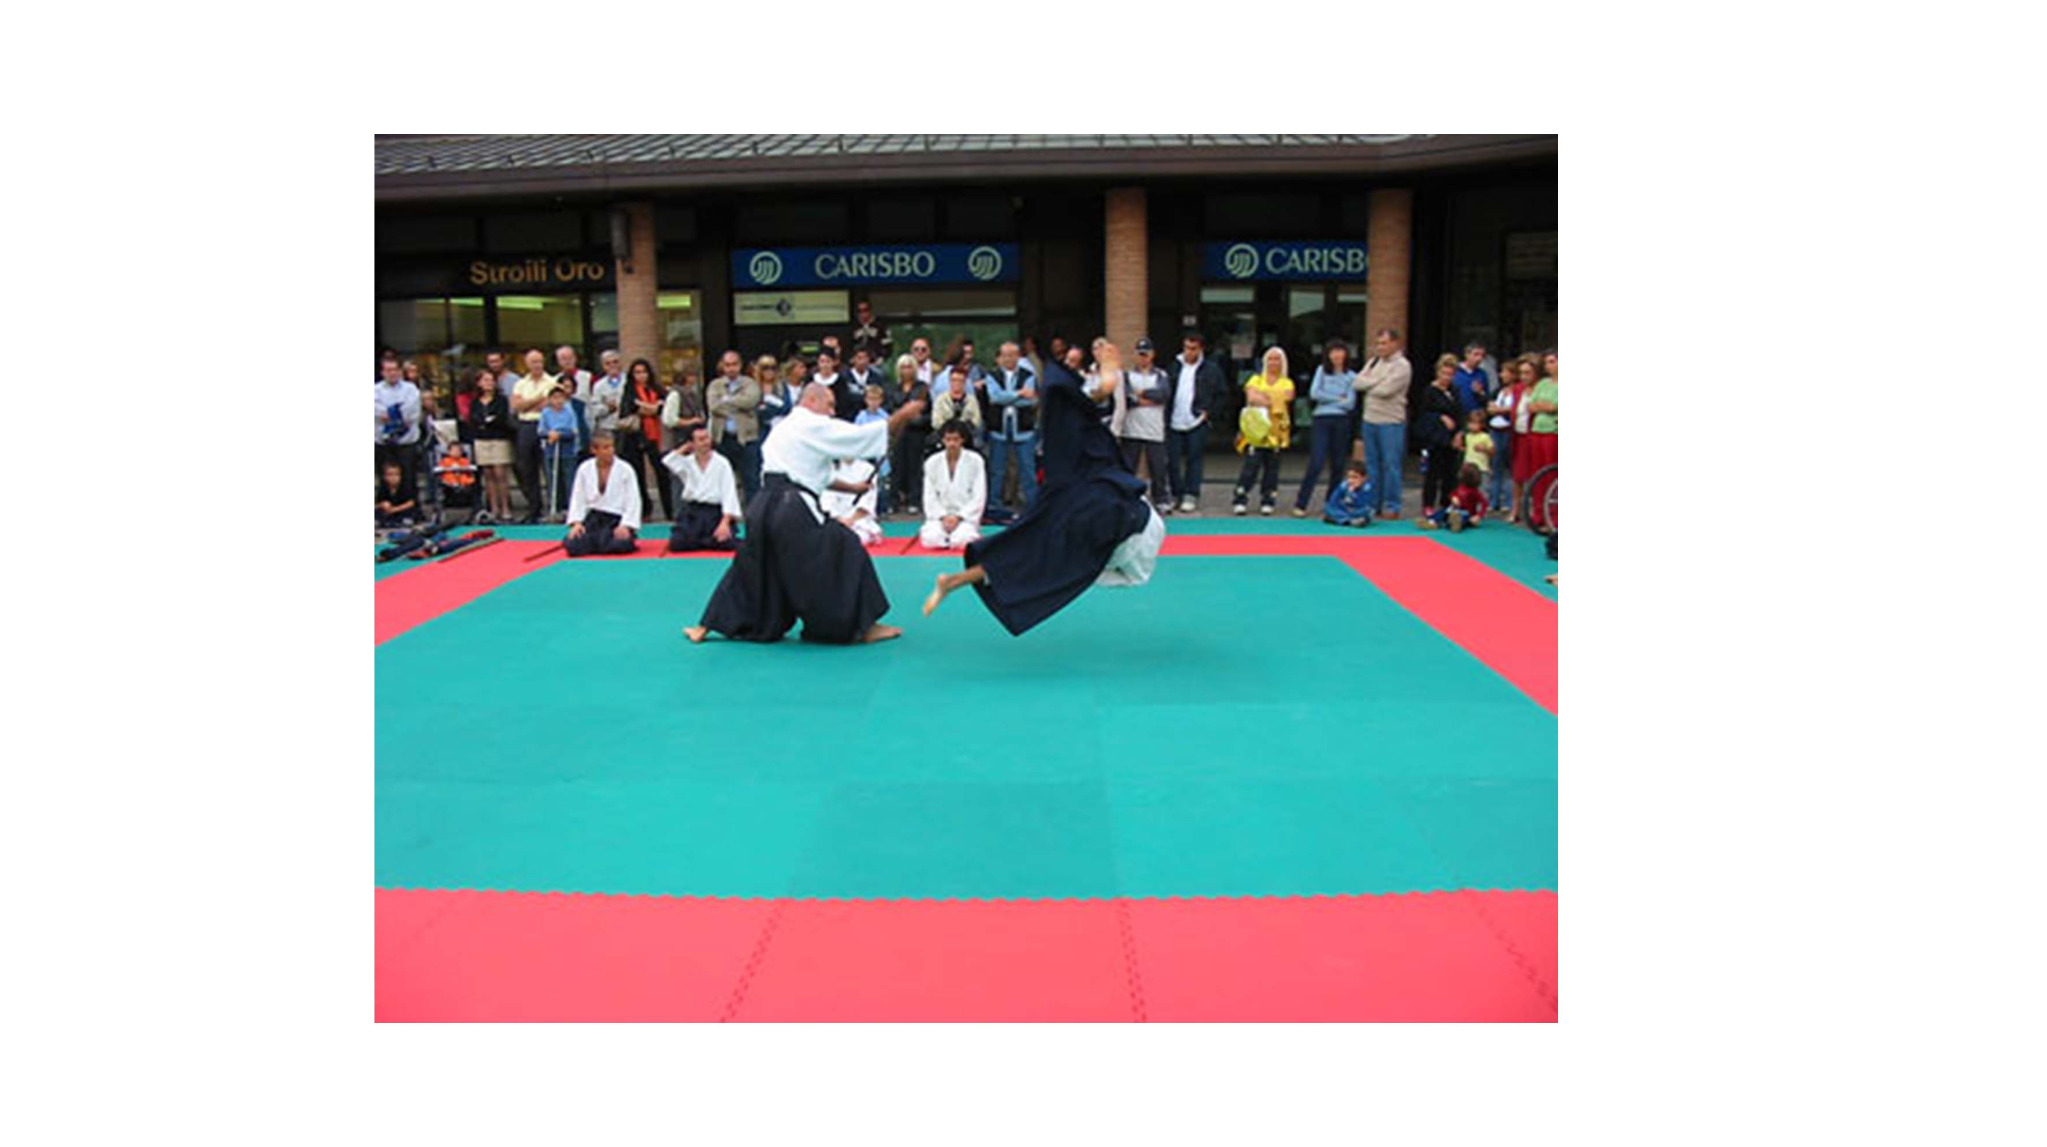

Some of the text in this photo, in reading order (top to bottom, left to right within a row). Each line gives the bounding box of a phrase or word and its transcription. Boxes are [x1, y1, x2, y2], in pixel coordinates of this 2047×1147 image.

[470, 258, 604, 285] Stroili Oro
[814, 251, 935, 279] CARISBO
[1265, 247, 1369, 274] CARISB
